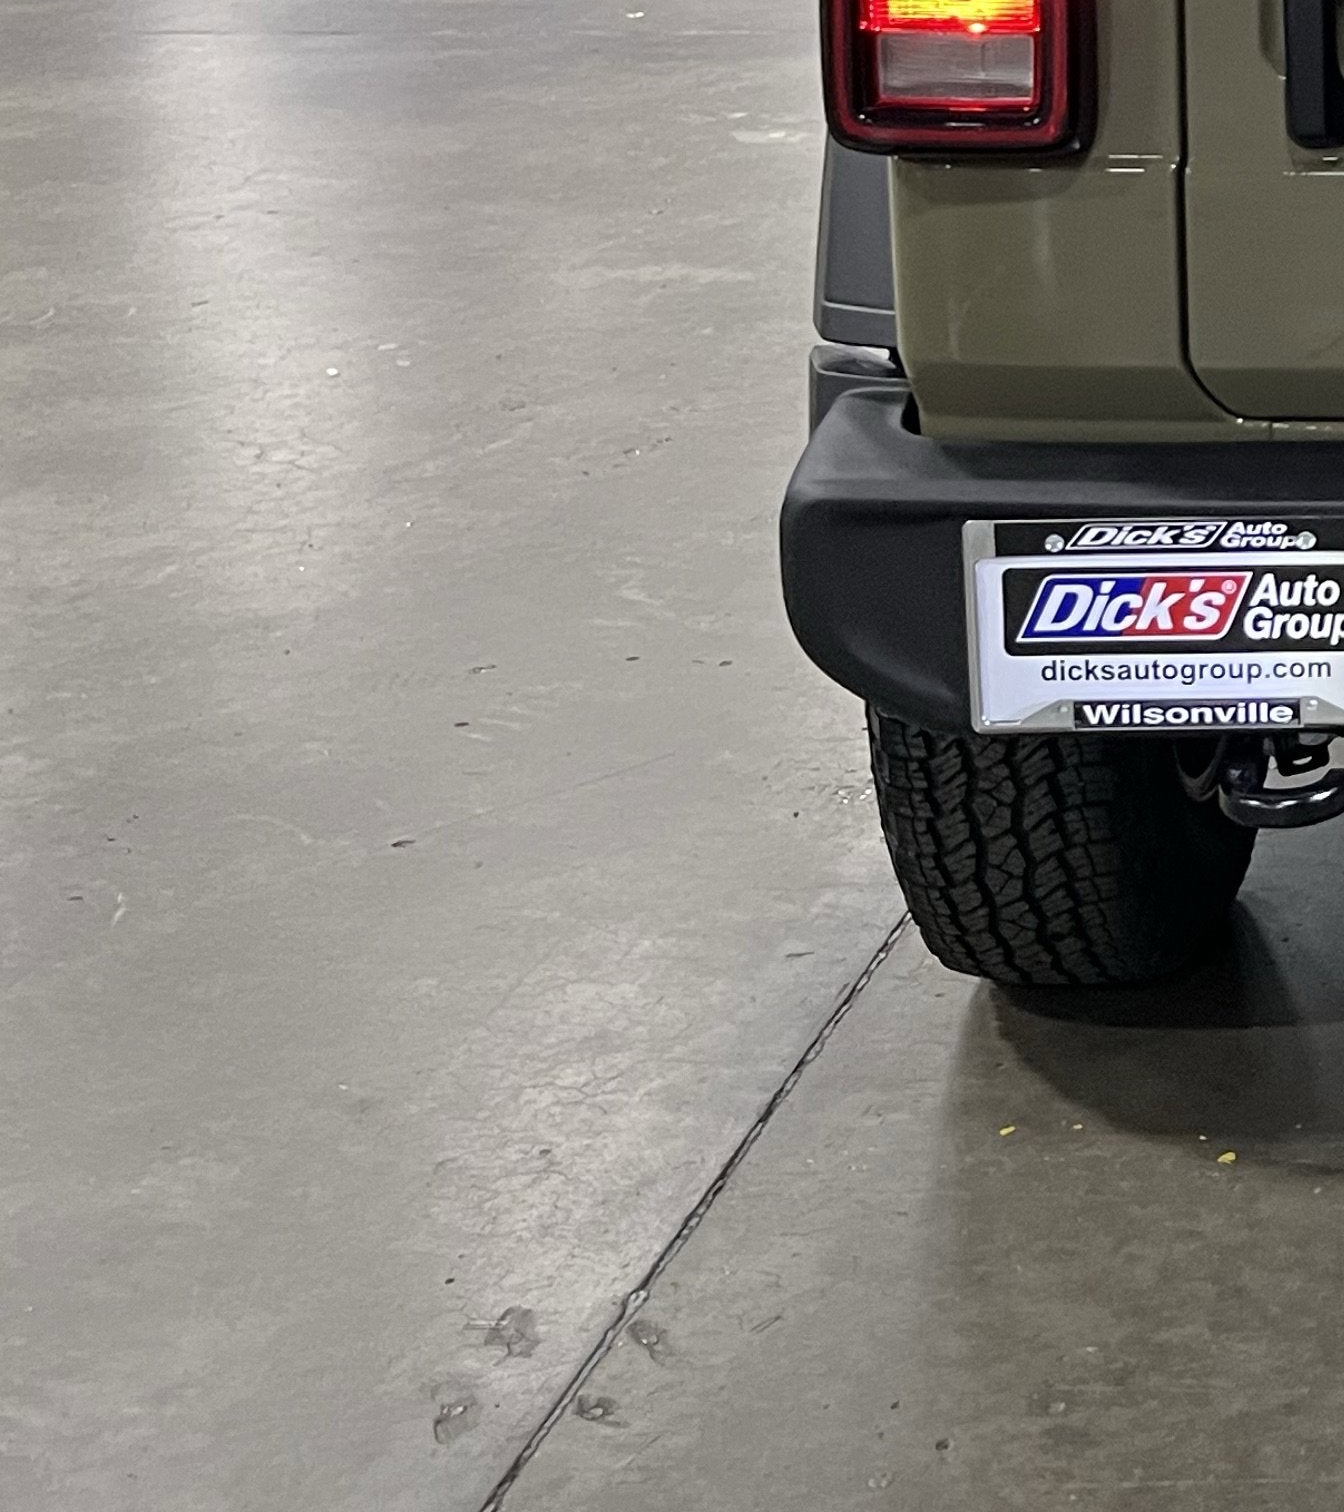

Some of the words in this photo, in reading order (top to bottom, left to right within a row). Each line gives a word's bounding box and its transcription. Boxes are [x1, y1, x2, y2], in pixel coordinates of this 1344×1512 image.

[1076, 524, 1217, 546] Dick's
[1227, 521, 1288, 536] Auto
[1220, 534, 1298, 550] Group
[1251, 574, 1341, 607] Auto
[1033, 579, 1226, 633] Dick's
[1041, 660, 1332, 685] dicksautogroup.com
[1082, 702, 1294, 726] Wilsonville
